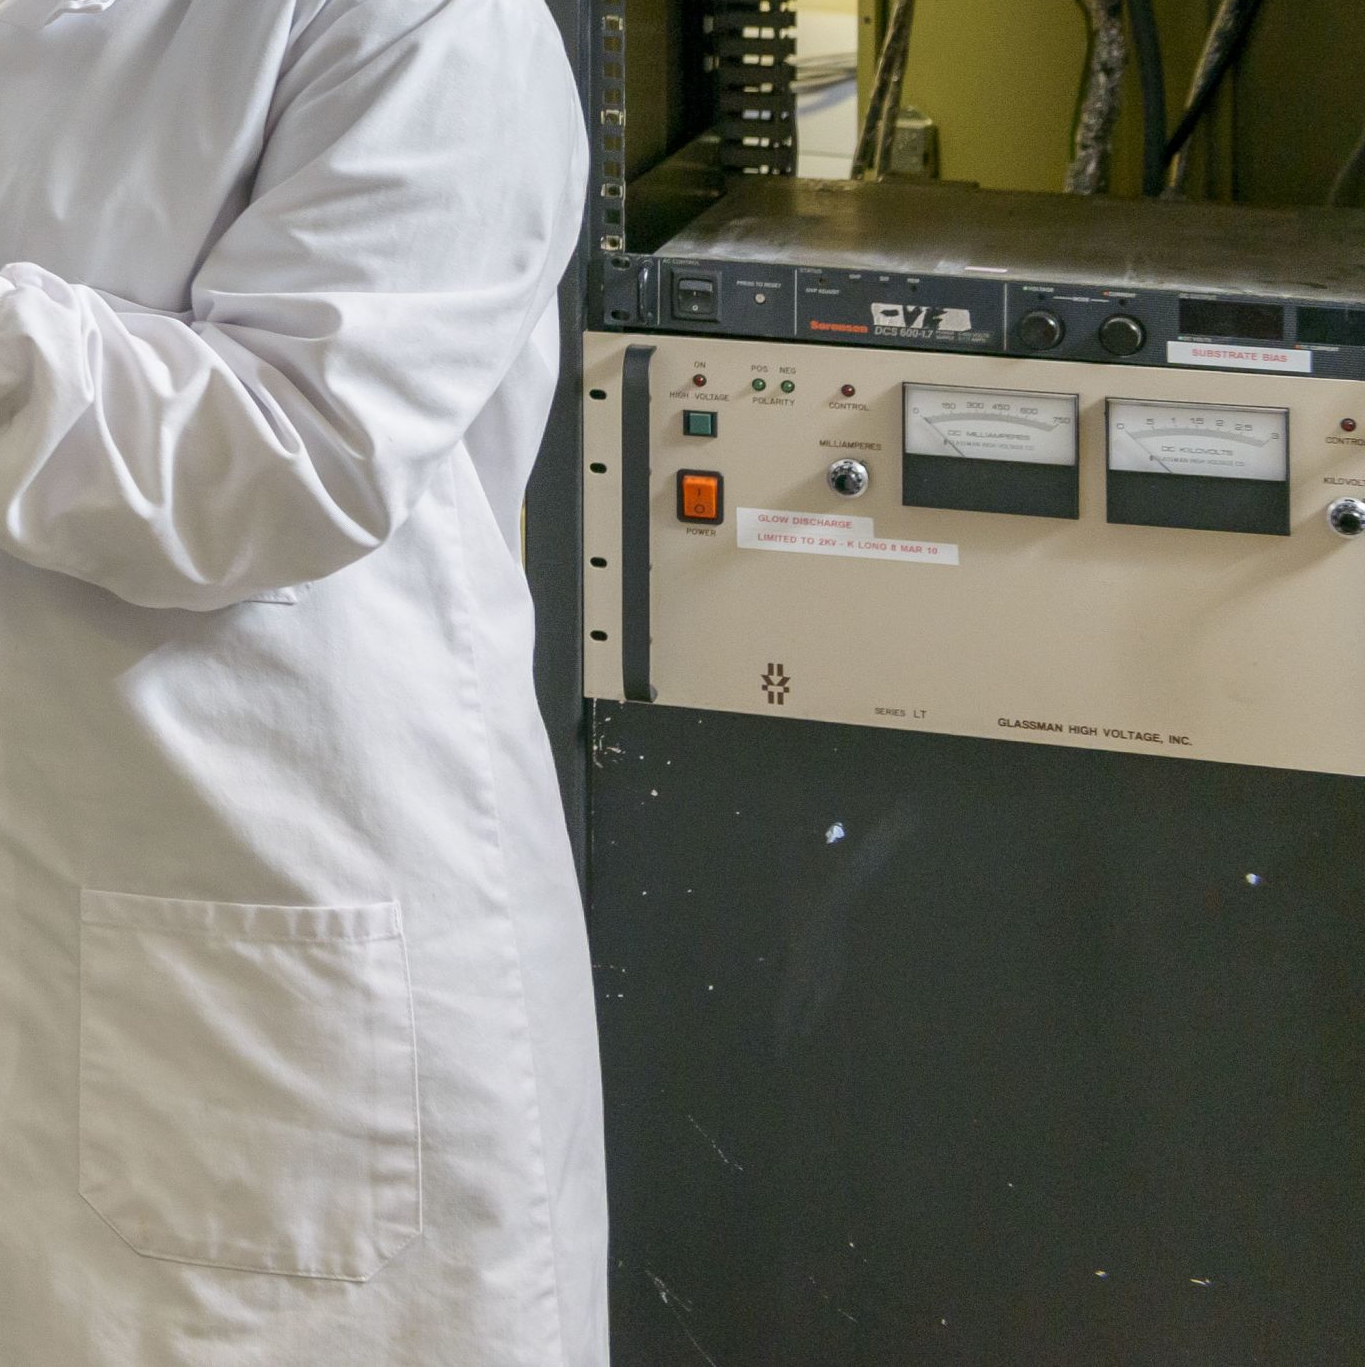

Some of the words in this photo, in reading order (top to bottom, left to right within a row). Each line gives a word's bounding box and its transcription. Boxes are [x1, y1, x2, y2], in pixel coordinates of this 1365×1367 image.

[874, 327, 898, 337] DCS
[1192, 348, 1257, 362] SUBSTRATE
[1263, 351, 1288, 363] BIAS
[694, 361, 706, 369] ON
[750, 365, 768, 373] POS
[779, 366, 796, 374] NEG
[669, 391, 689, 399] HIGH
[695, 393, 730, 402] VOLTAGE
[752, 397, 795, 407] POLARITY
[828, 401, 870, 411] CONTROL
[941, 402, 957, 410] 150
[966, 402, 984, 410] 300
[992, 403, 1011, 411] 450
[1020, 407, 1038, 415] 600
[1053, 416, 1070, 425] 750
[1215, 419, 1224, 427] 2
[1271, 432, 1279, 440] 3
[819, 439, 882, 451] MILLIAMPERES
[758, 514, 789, 524] GLOW
[792, 517, 853, 530] DISCHARGE
[686, 528, 716, 537] POWER
[757, 533, 797, 544] LIMITED
[801, 536, 815, 545] TO
[819, 537, 837, 547] 2KV
[858, 541, 887, 552] LONG
[891, 544, 897, 552] 8
[901, 545, 923, 554] MAR
[874, 707, 906, 718] SERIES
[913, 710, 927, 719] LT
[998, 717, 1063, 733] GLASSMAN
[1069, 725, 1097, 737] HIGH
[1103, 728, 1164, 744] VOLTAGE,
[1169, 734, 1193, 746] INC.
